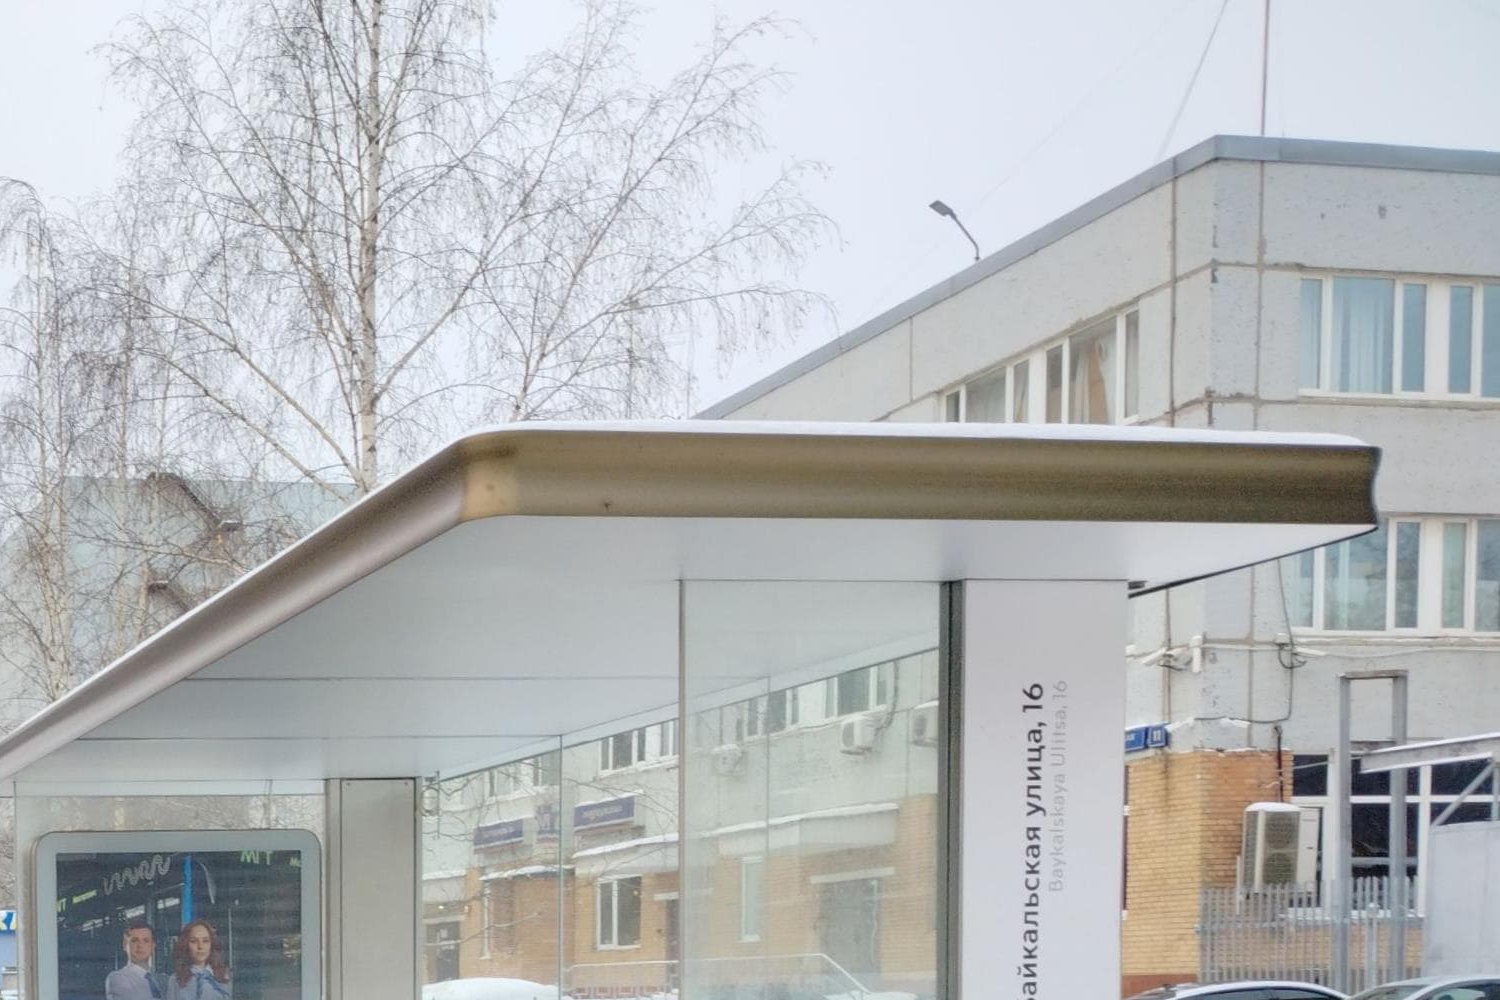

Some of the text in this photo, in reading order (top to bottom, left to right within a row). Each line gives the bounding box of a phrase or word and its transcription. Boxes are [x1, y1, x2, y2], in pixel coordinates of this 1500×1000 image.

[1022, 682, 1044, 713] 16
[1053, 680, 1068, 700] 16
[1027, 720, 1048, 817] улица,
[1048, 773, 1068, 892] Baykalskaya
